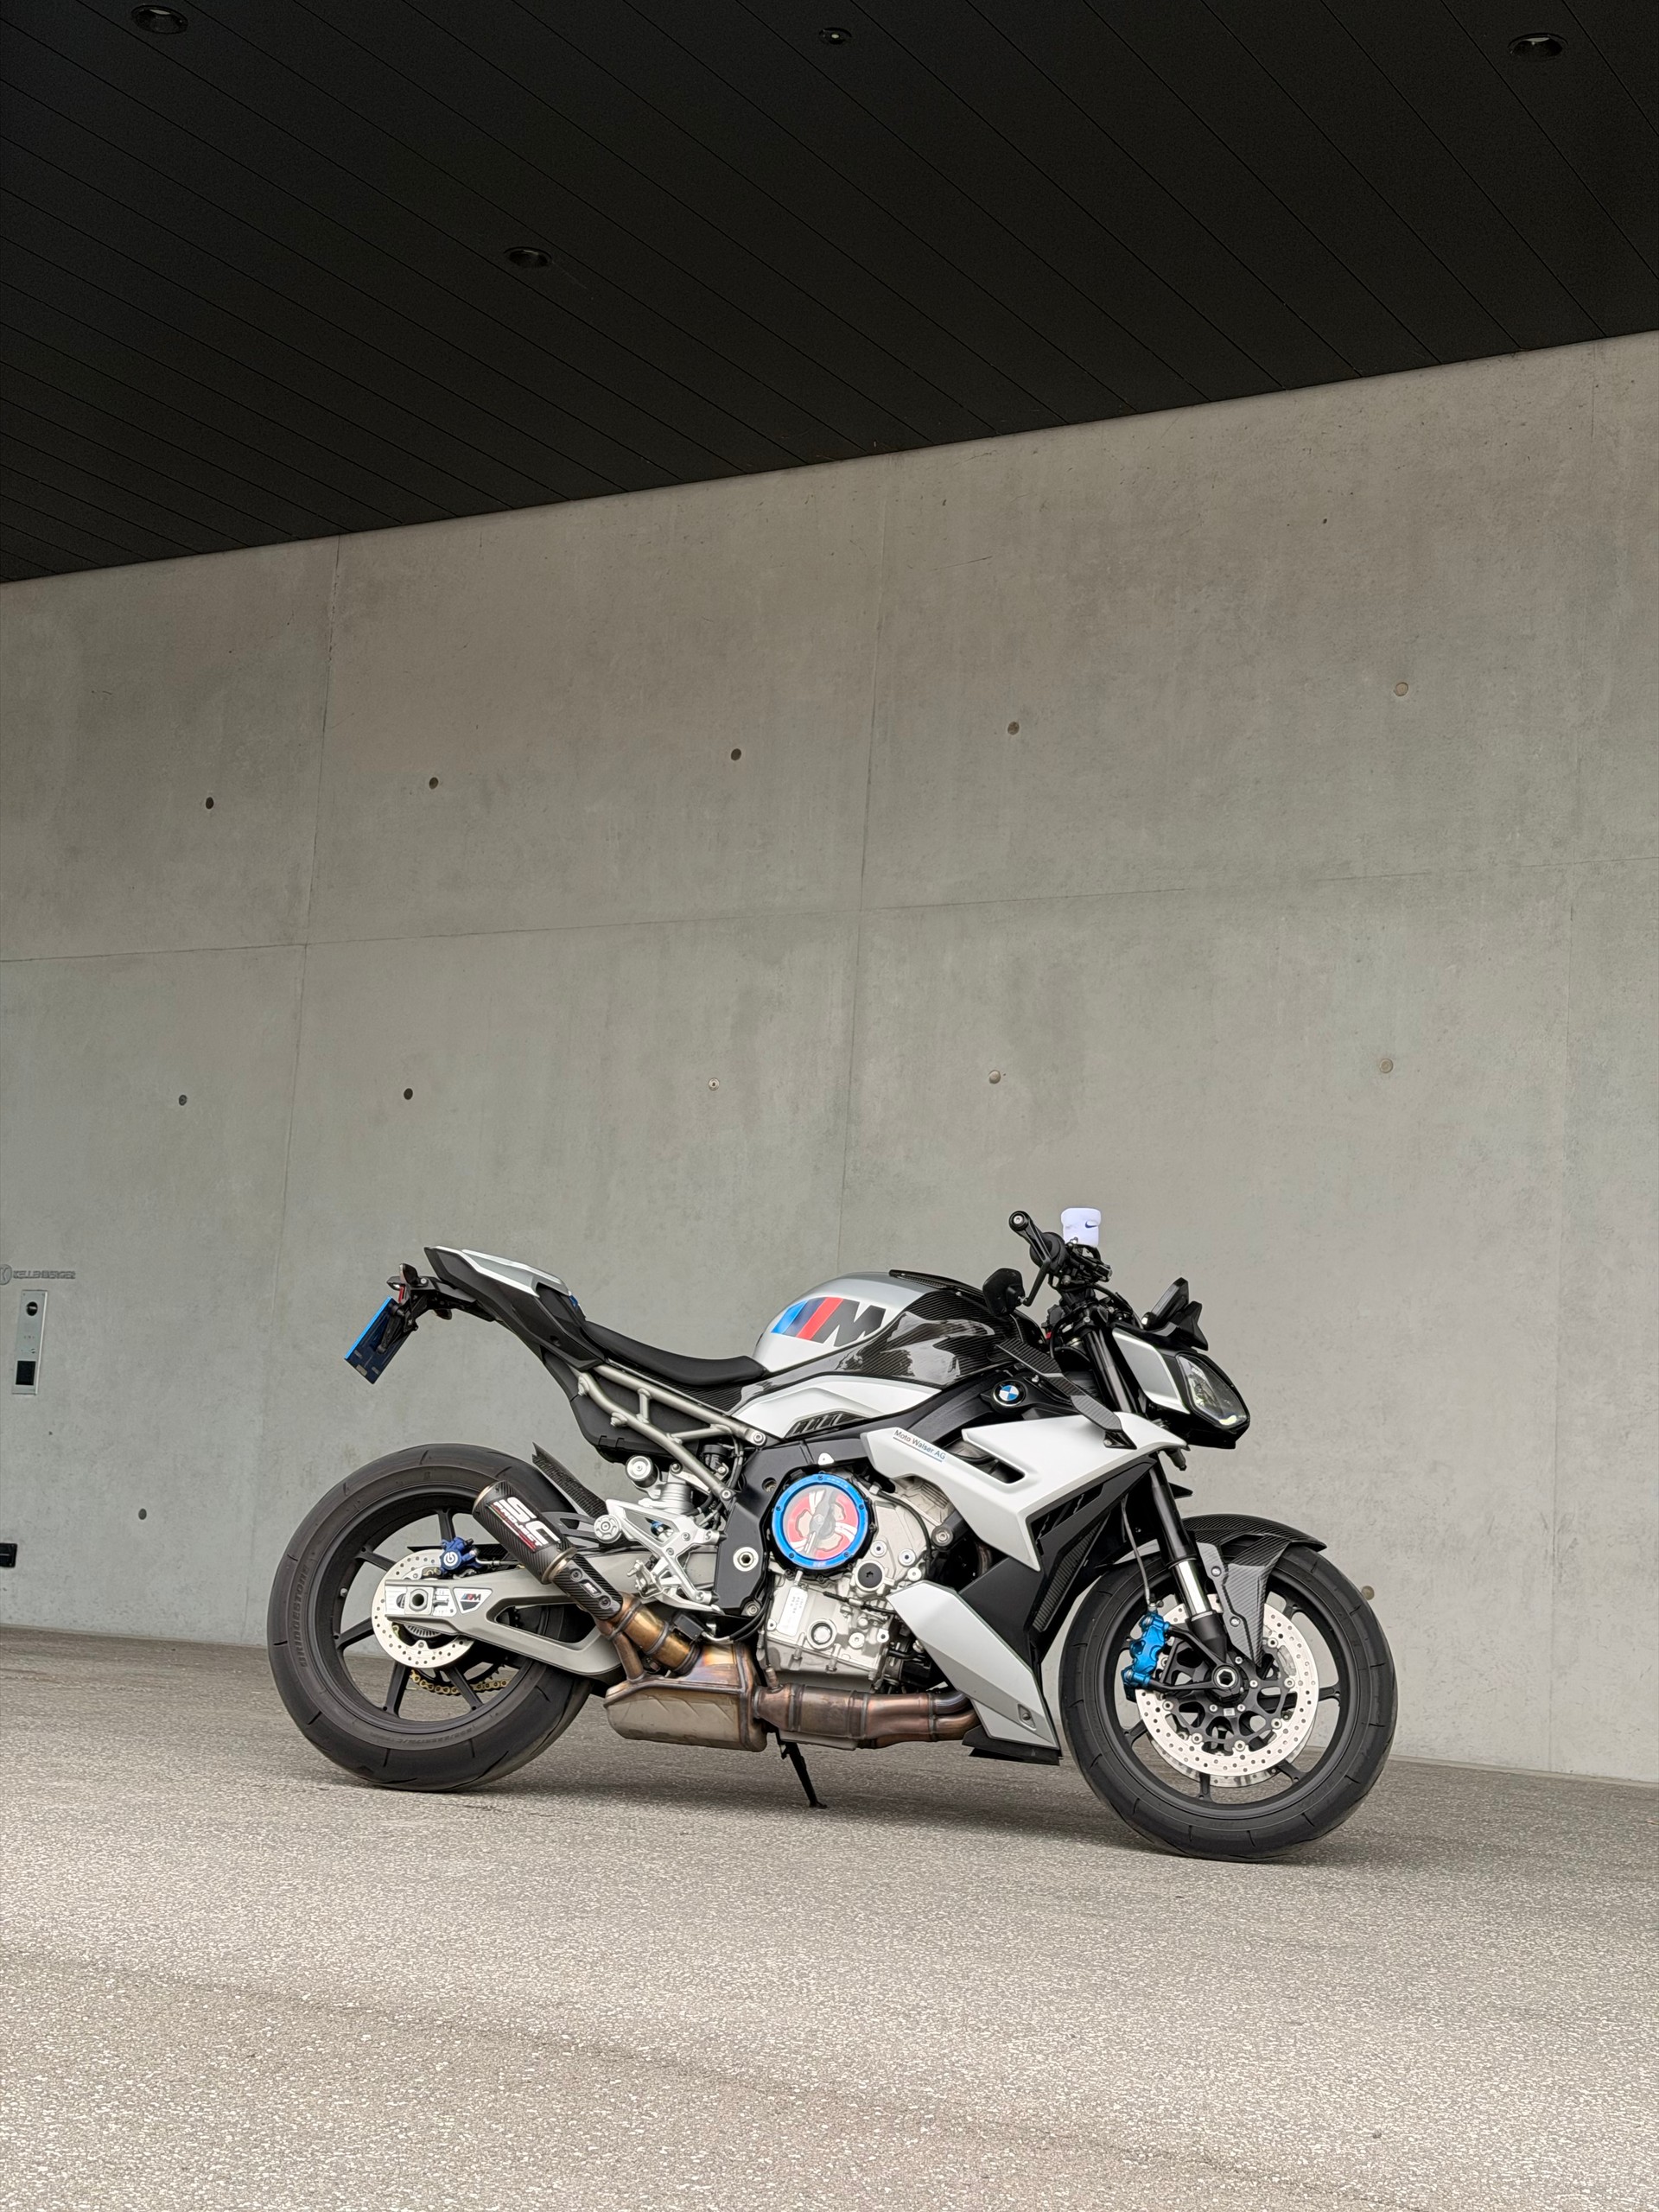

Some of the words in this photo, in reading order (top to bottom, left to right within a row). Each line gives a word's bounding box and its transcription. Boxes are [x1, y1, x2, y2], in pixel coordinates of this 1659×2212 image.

[894, 1430, 912, 1442] Moto
[912, 1438, 934, 1453] Walser
[934, 1450, 946, 1460] AG
[493, 1501, 543, 1547] PROJECT
[499, 1497, 562, 1545] SC
[290, 1564, 311, 1668] BRIDGESTONE
